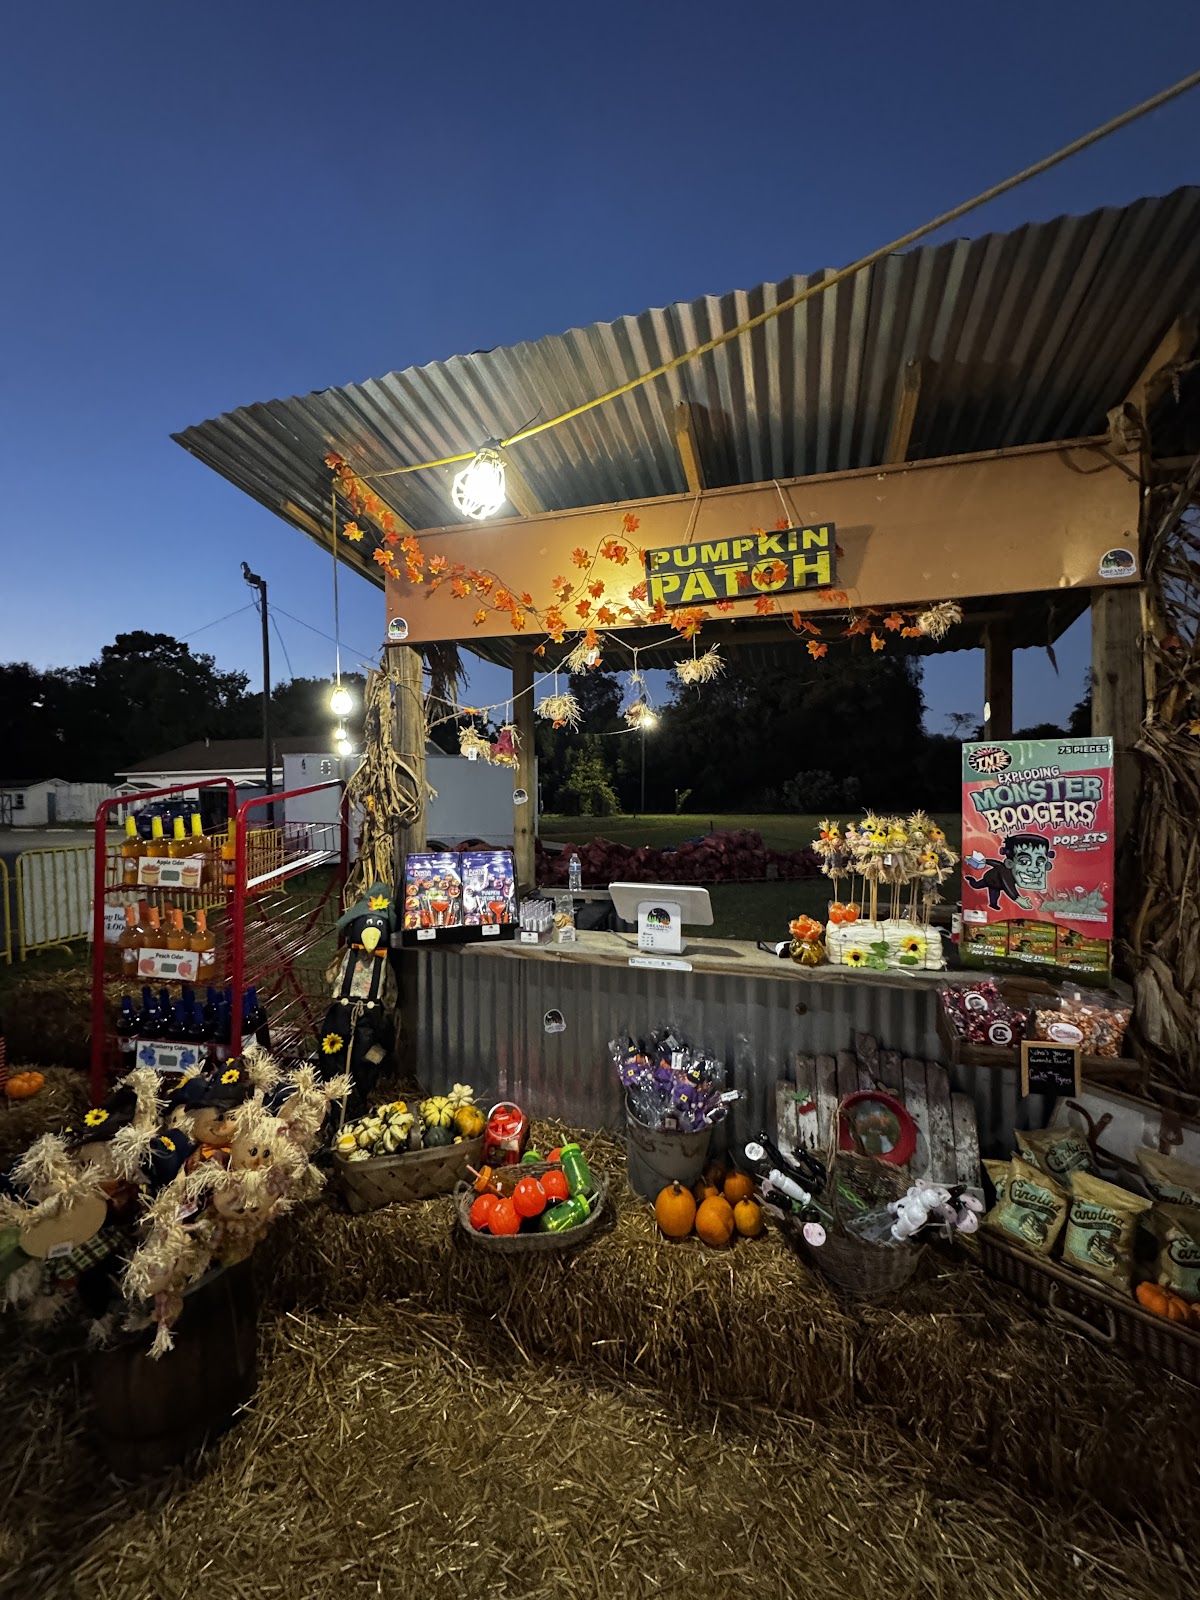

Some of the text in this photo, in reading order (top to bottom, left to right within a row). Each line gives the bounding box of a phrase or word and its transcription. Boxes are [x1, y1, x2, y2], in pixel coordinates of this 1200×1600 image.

[650, 527, 828, 571] PUMPKIN
[651, 551, 830, 606] PATCH
[976, 752, 1002, 769] TNT
[1059, 744, 1108, 754] 75 PIECES
[997, 765, 1060, 784] EXPLODING
[971, 776, 1103, 812] MONSTER
[982, 800, 1097, 831] BOOGERS
[1009, 1179, 1064, 1213] Carolina
[1069, 1199, 1125, 1227] Carolina
